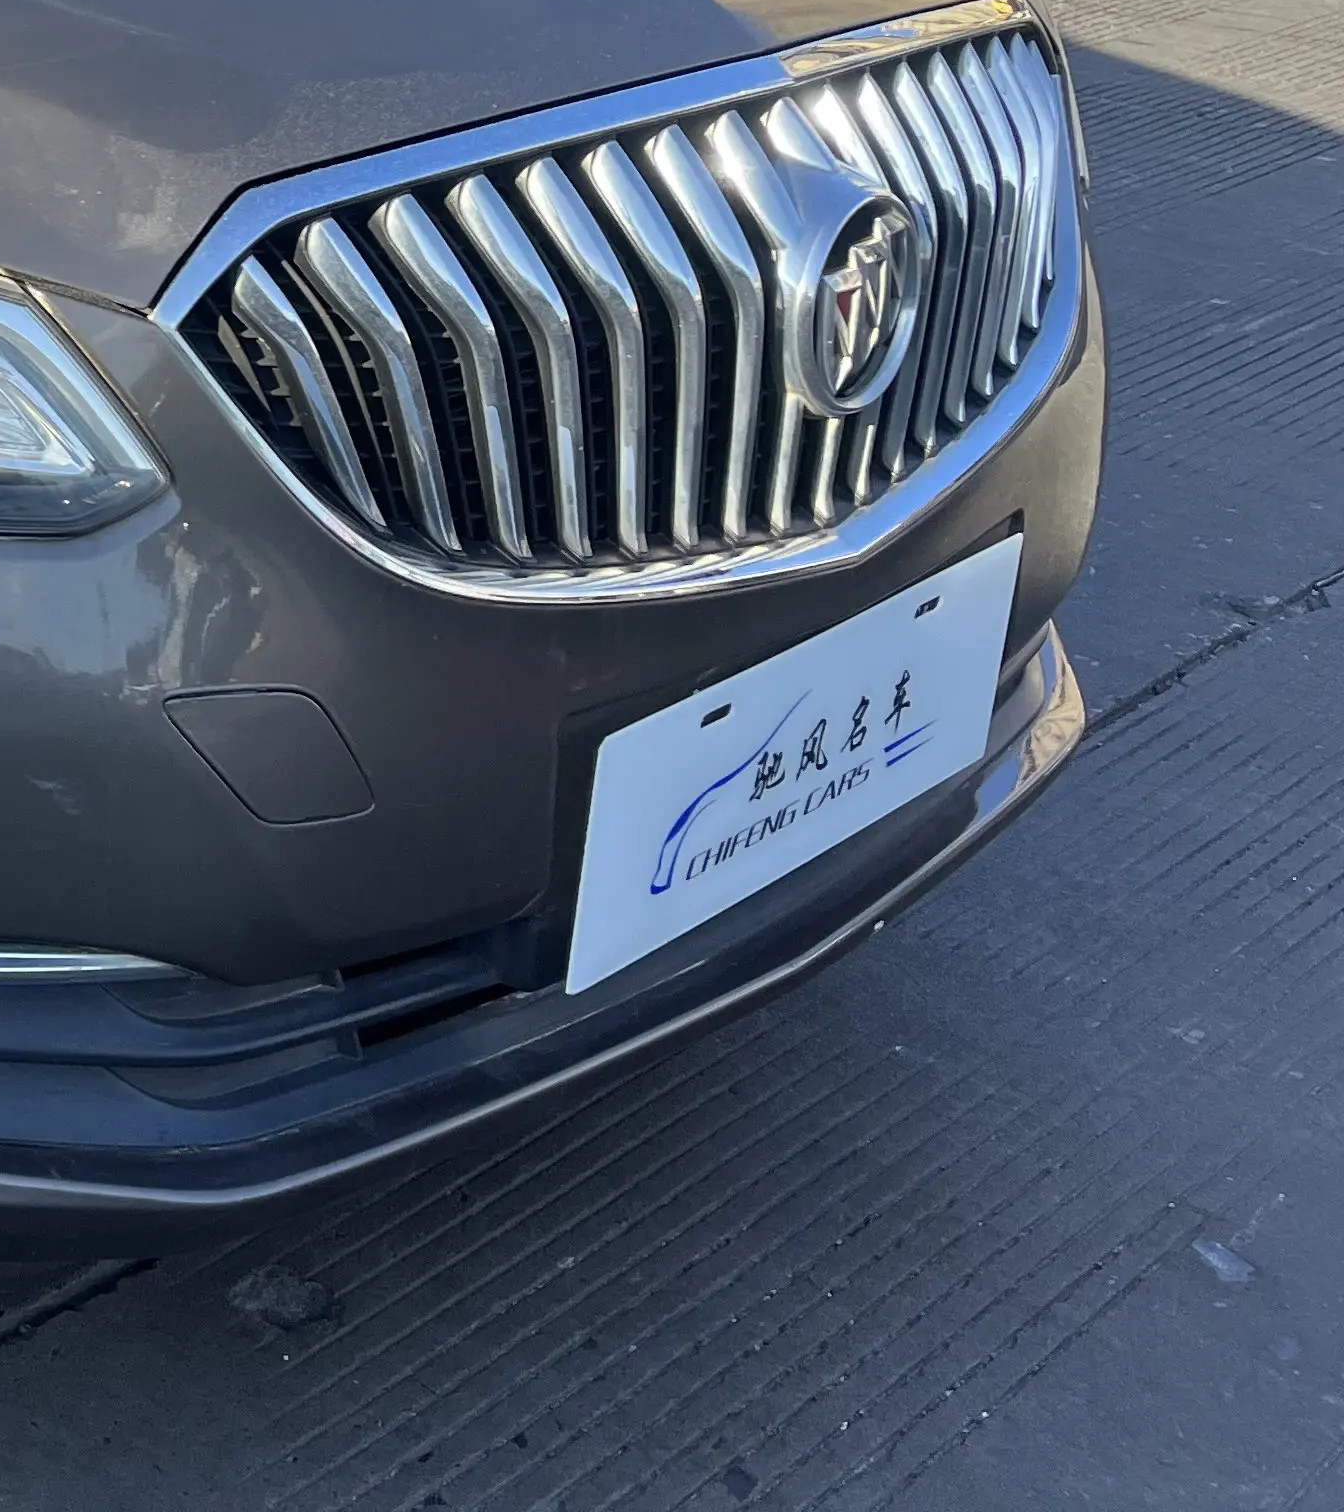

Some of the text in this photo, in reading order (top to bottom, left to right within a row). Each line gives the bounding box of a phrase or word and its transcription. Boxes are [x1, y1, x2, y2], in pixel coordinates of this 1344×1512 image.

[749, 669, 912, 803] 驰风名车
[685, 758, 875, 882] CHIFENG CARS
